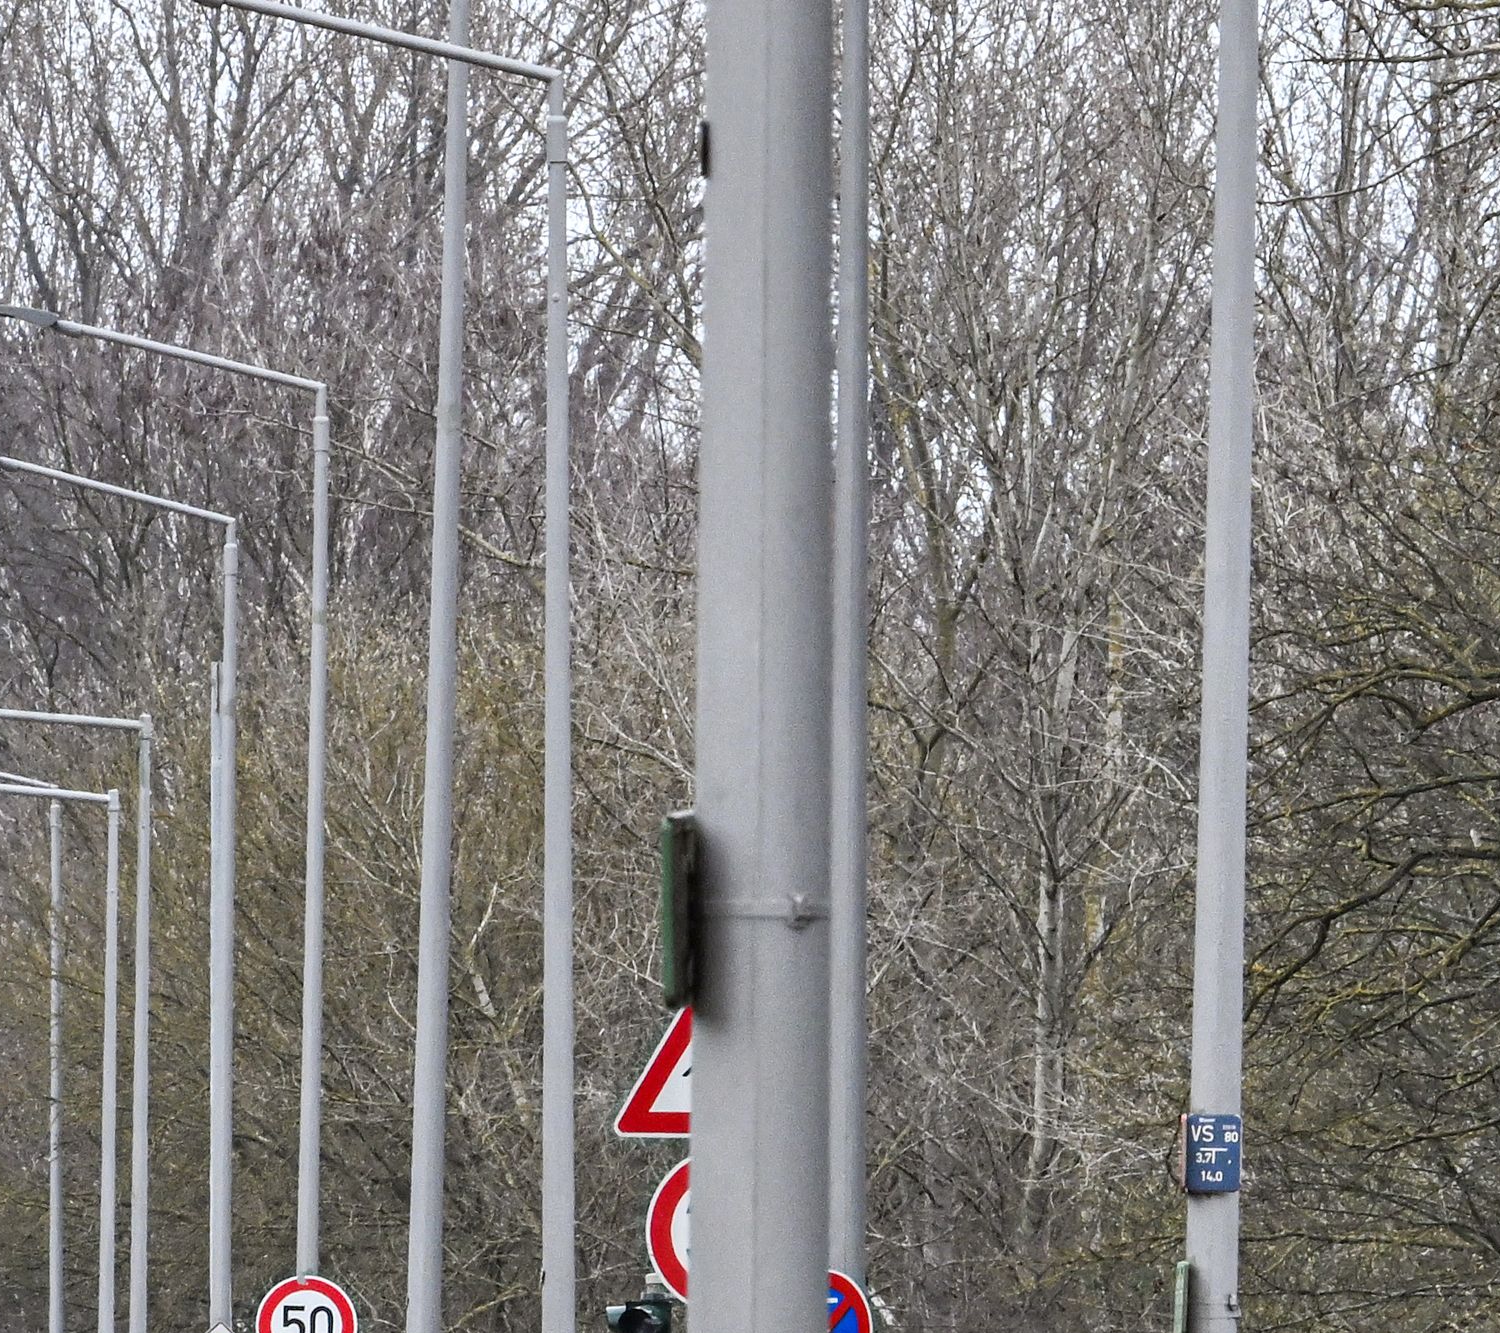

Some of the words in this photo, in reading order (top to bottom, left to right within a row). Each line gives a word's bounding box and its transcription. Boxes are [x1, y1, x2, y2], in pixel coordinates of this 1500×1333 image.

[1191, 1125, 1214, 1142] VS
[1224, 1131, 1239, 1143] 80
[1201, 1170, 1223, 1182] 14.0
